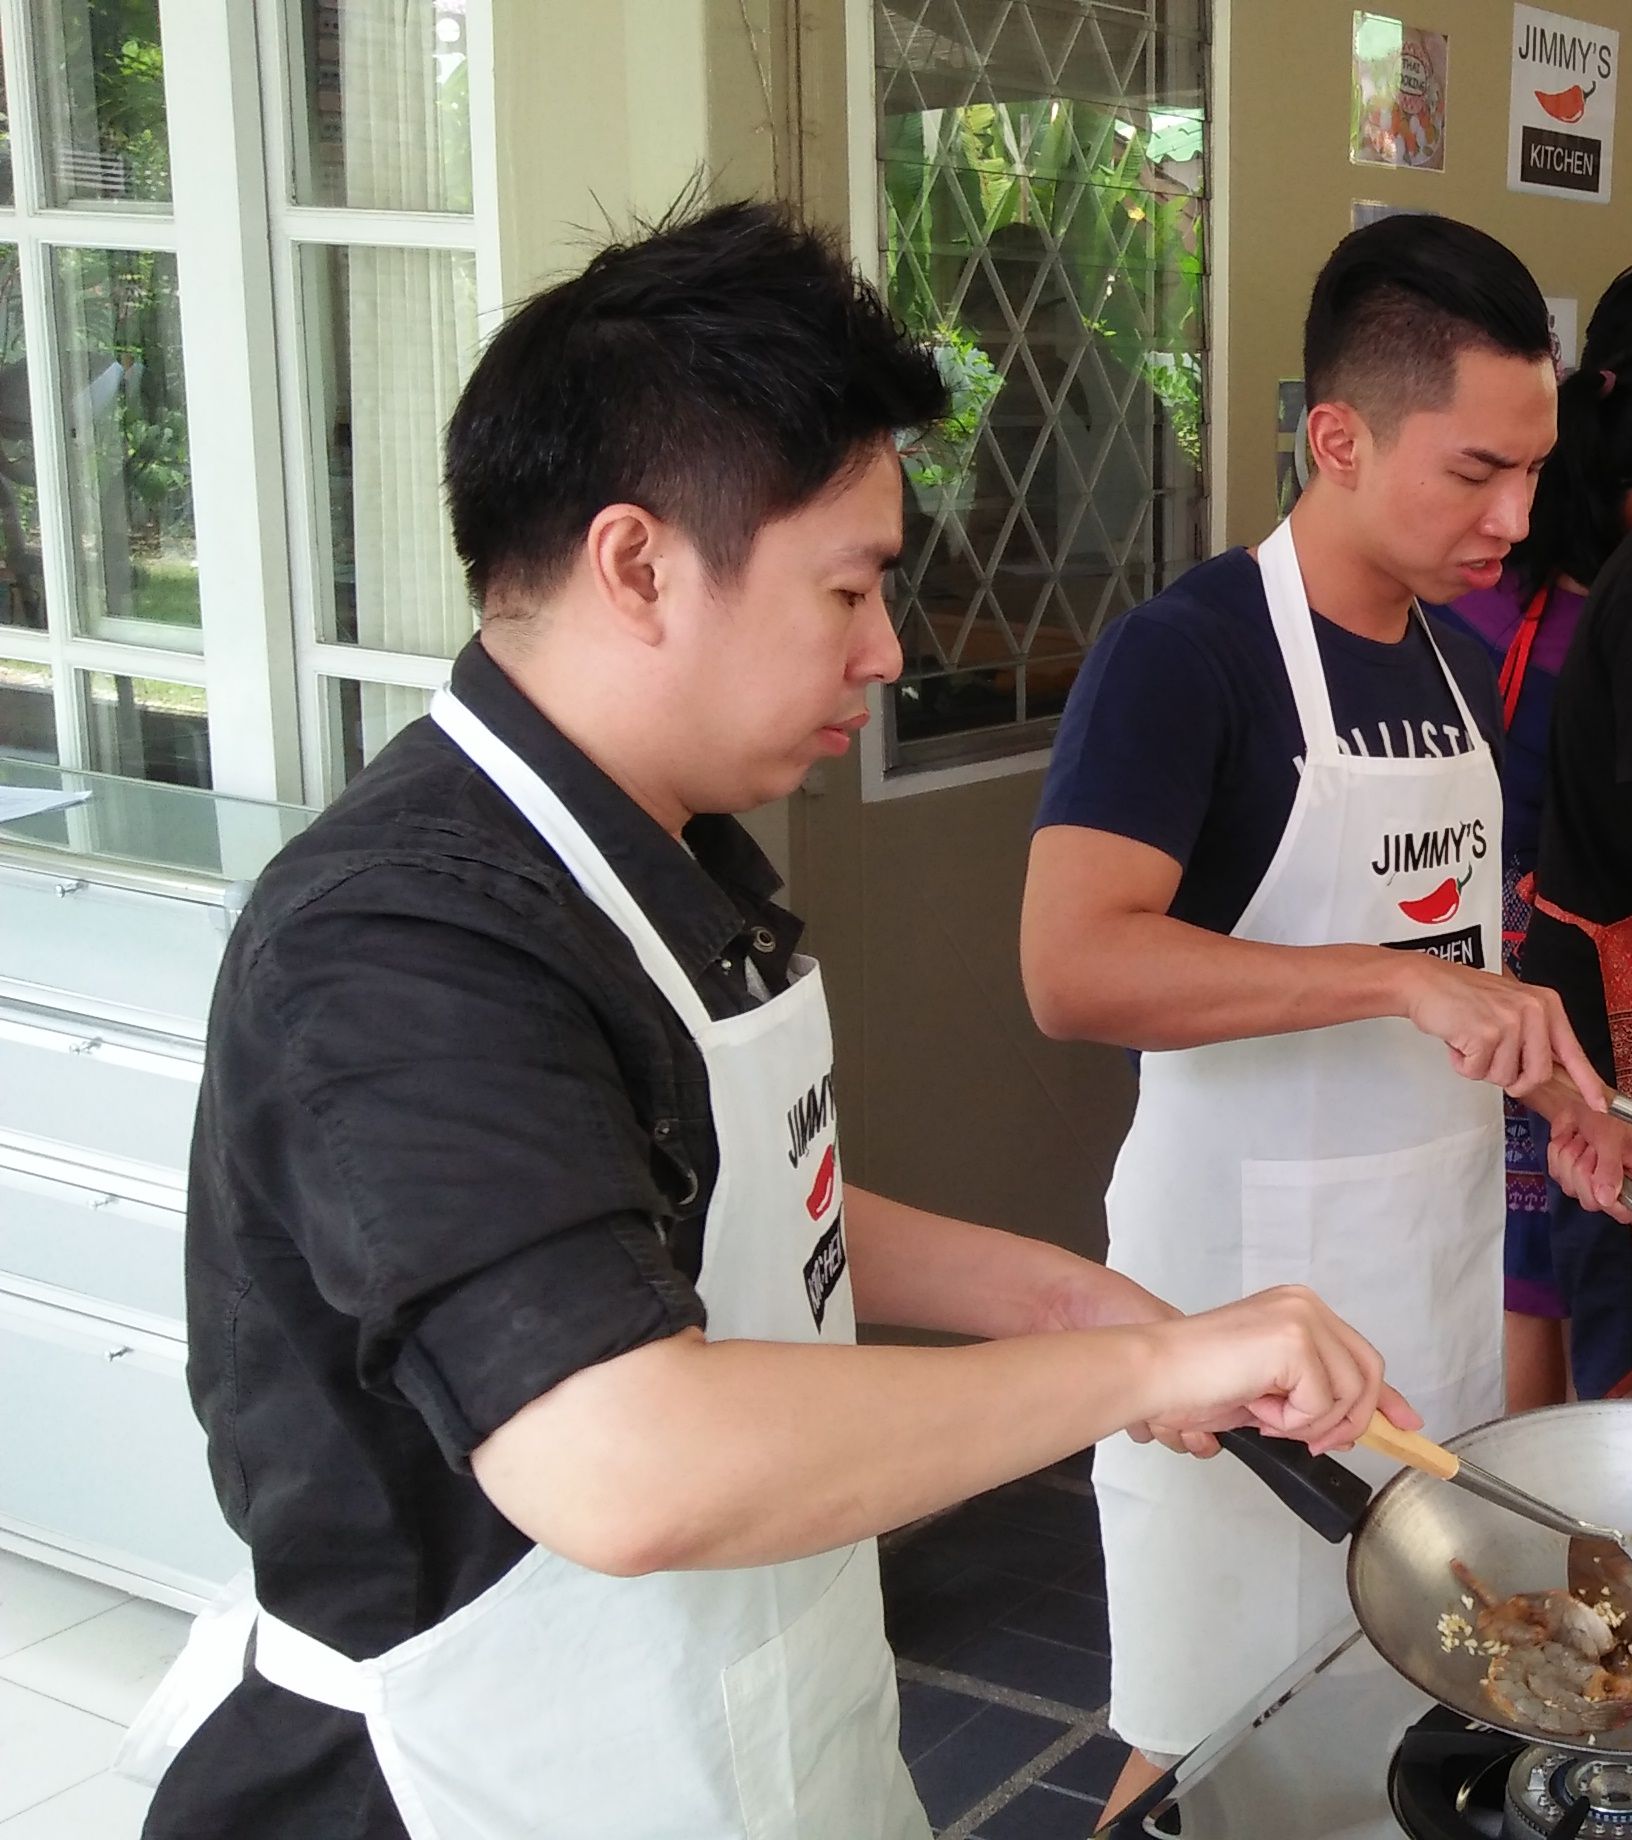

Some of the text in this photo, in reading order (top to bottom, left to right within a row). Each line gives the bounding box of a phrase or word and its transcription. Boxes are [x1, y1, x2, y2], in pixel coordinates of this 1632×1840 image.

[1518, 24, 1612, 80] JIMMY'S
[1529, 142, 1594, 178] KITCHEN
[1371, 819, 1487, 876] JIMMY'S
